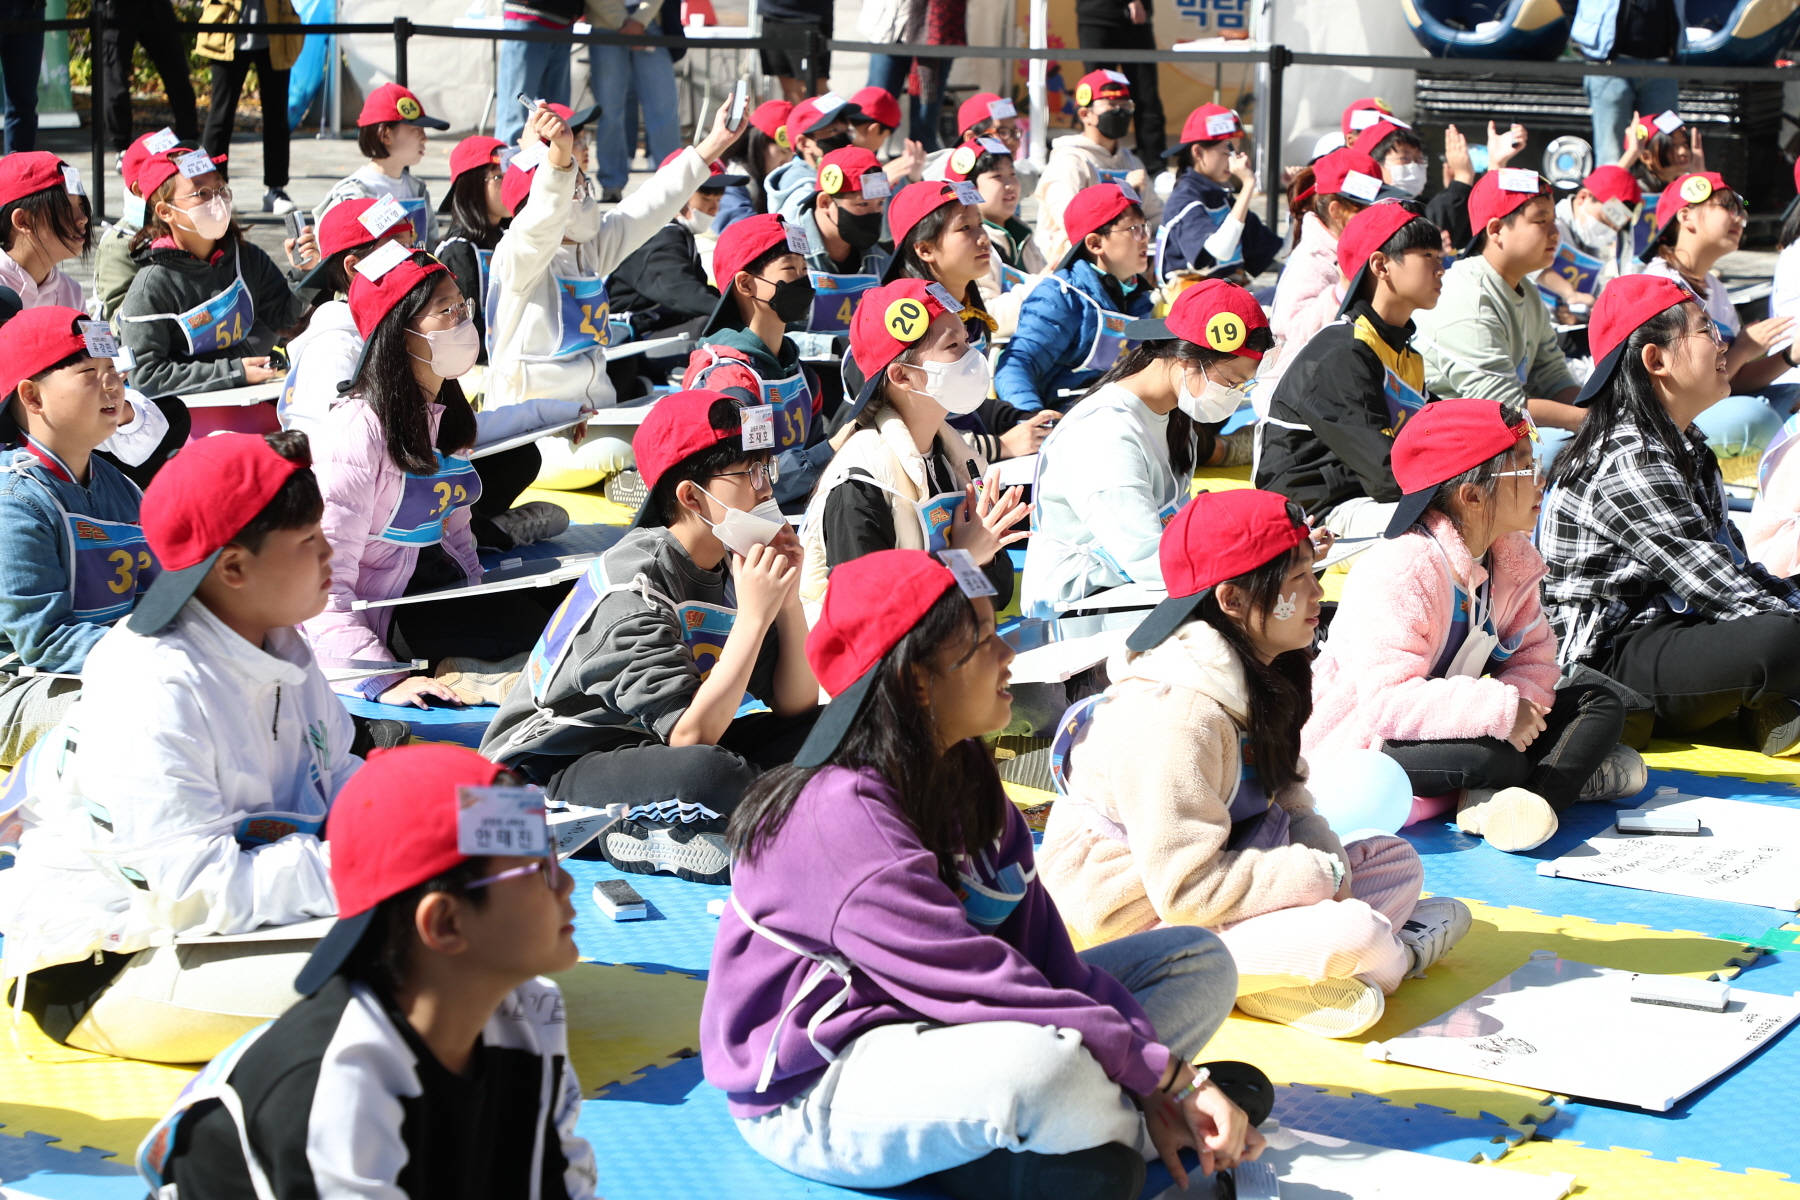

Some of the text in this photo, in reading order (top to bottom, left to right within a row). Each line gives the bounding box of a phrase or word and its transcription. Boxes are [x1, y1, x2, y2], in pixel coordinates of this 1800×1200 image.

[401, 101, 417, 115] 64
[823, 170, 839, 187] 41
[1686, 179, 1707, 197] 16
[891, 302, 920, 336] 20
[215, 311, 242, 350] 54
[1210, 322, 1238, 344] 19
[781, 407, 805, 446] 31
[748, 431, 768, 444] 조재호
